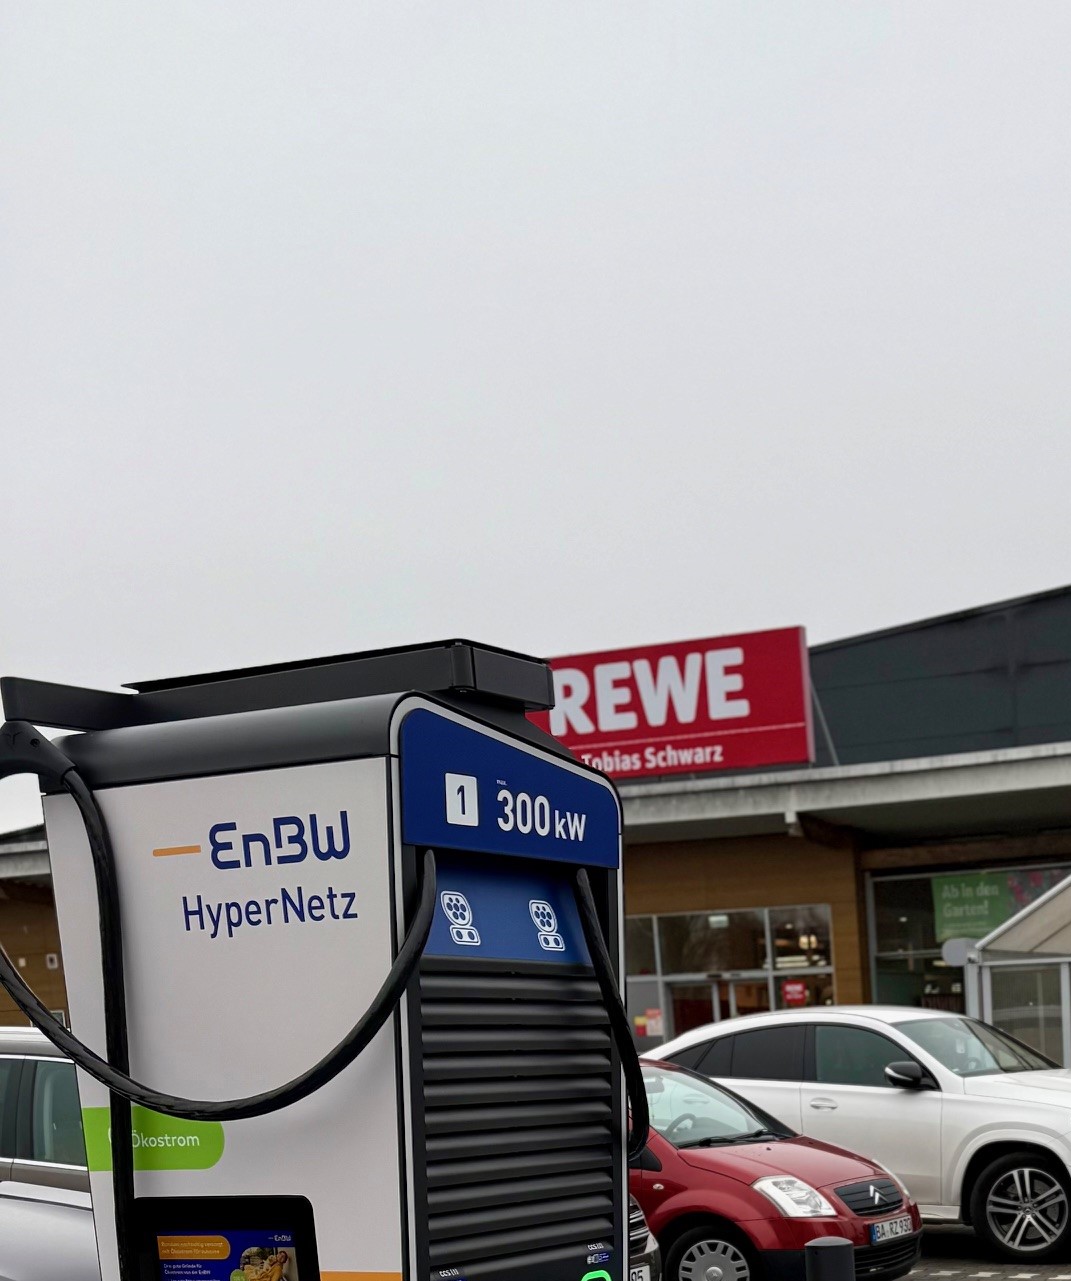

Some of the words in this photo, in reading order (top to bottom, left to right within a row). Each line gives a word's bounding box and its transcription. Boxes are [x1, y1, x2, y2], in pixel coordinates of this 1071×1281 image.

[549, 647, 750, 736] REWE
[581, 749, 641, 773] Tobias
[644, 744, 724, 769] Schwarz
[208, 810, 351, 870] EnBW
[457, 785, 466, 815] 1
[497, 789, 551, 837] 300
[554, 810, 586, 842] kW
[182, 886, 358, 939] HyperNetz
[942, 885, 959, 898] Ab
[976, 881, 999, 897] den
[943, 901, 989, 918] Garten!
